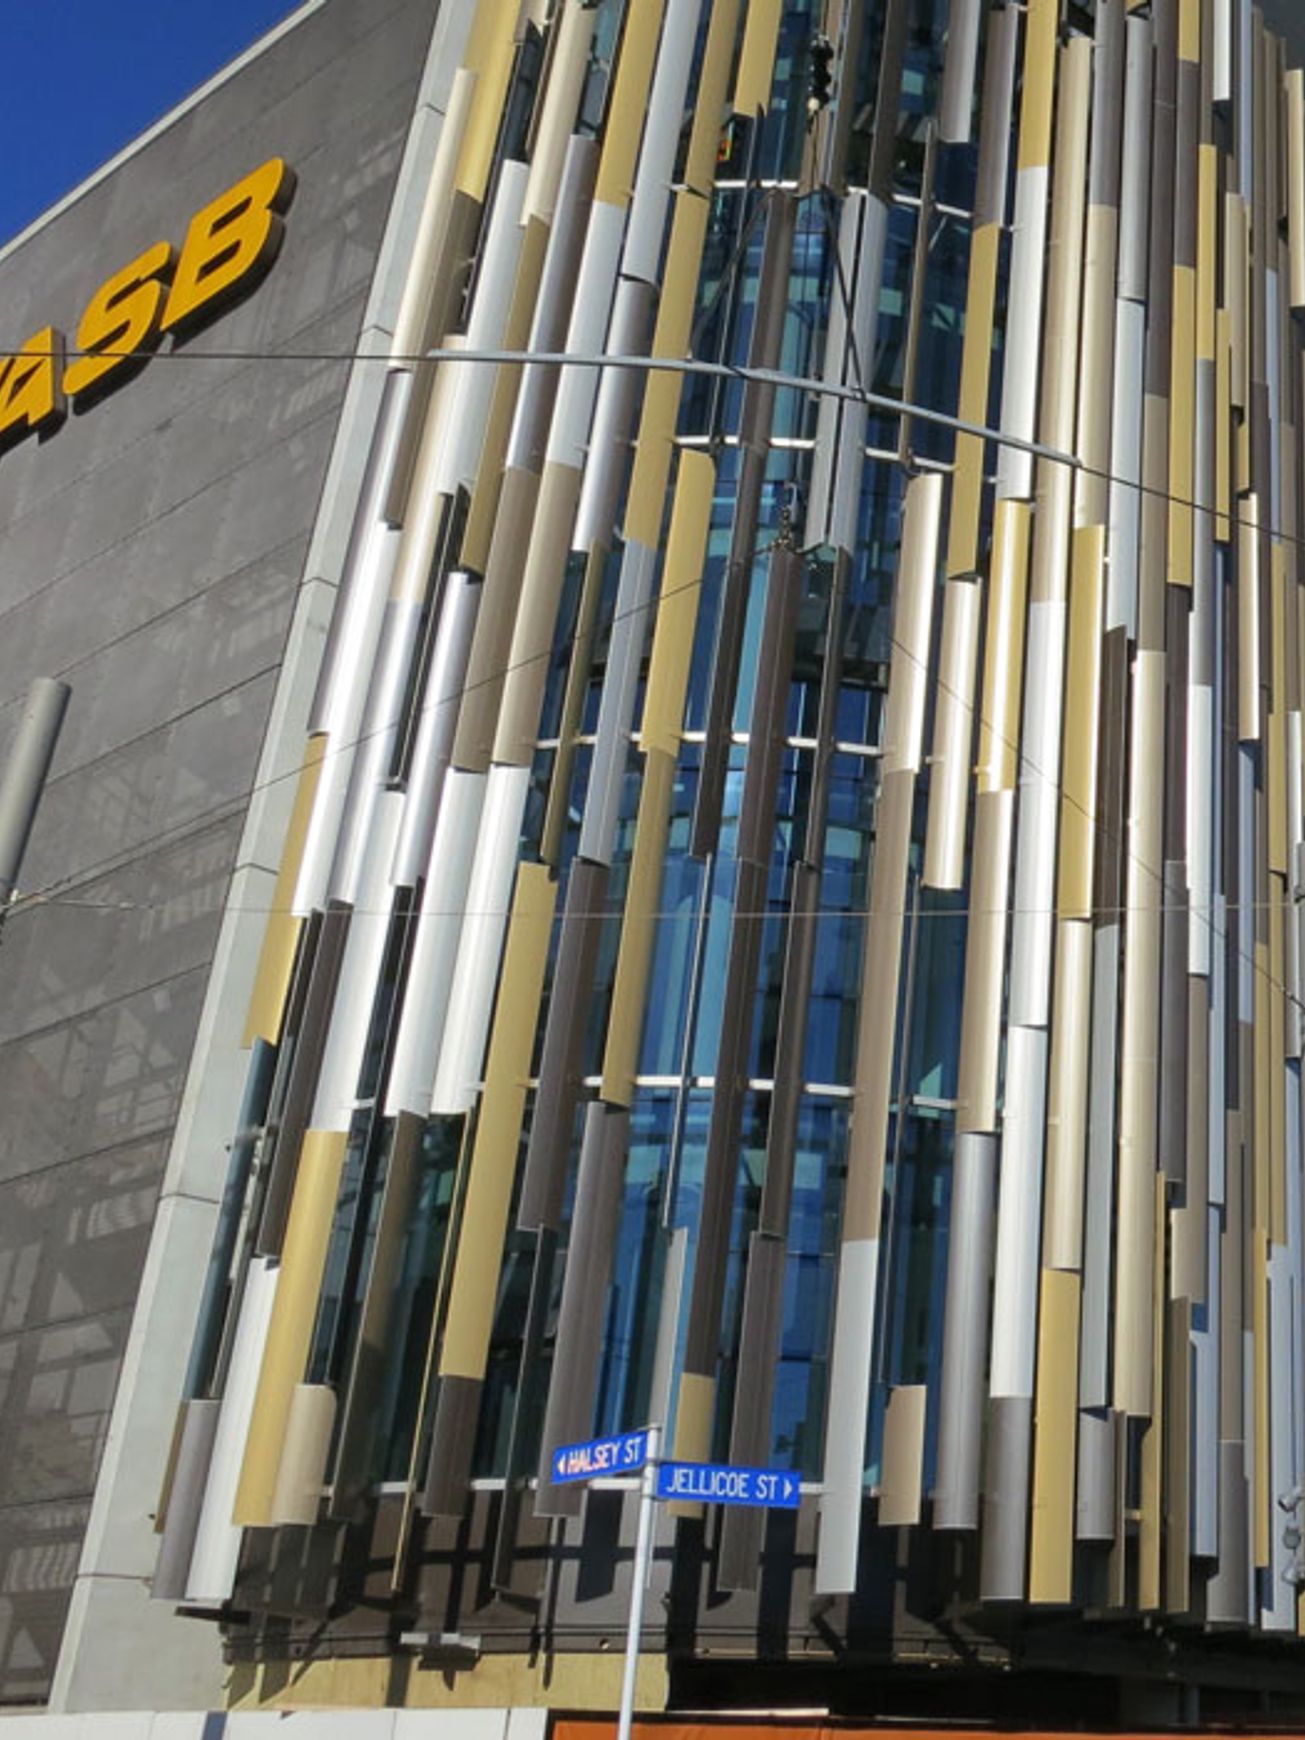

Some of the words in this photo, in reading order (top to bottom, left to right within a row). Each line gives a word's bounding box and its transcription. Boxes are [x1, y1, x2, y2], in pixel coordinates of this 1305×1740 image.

[0, 156, 290, 437] ASB
[566, 1444, 617, 1473] HALSEY
[624, 1436, 643, 1464] ST
[666, 1468, 750, 1498] JELLICOE
[755, 1475, 779, 1500] ST
